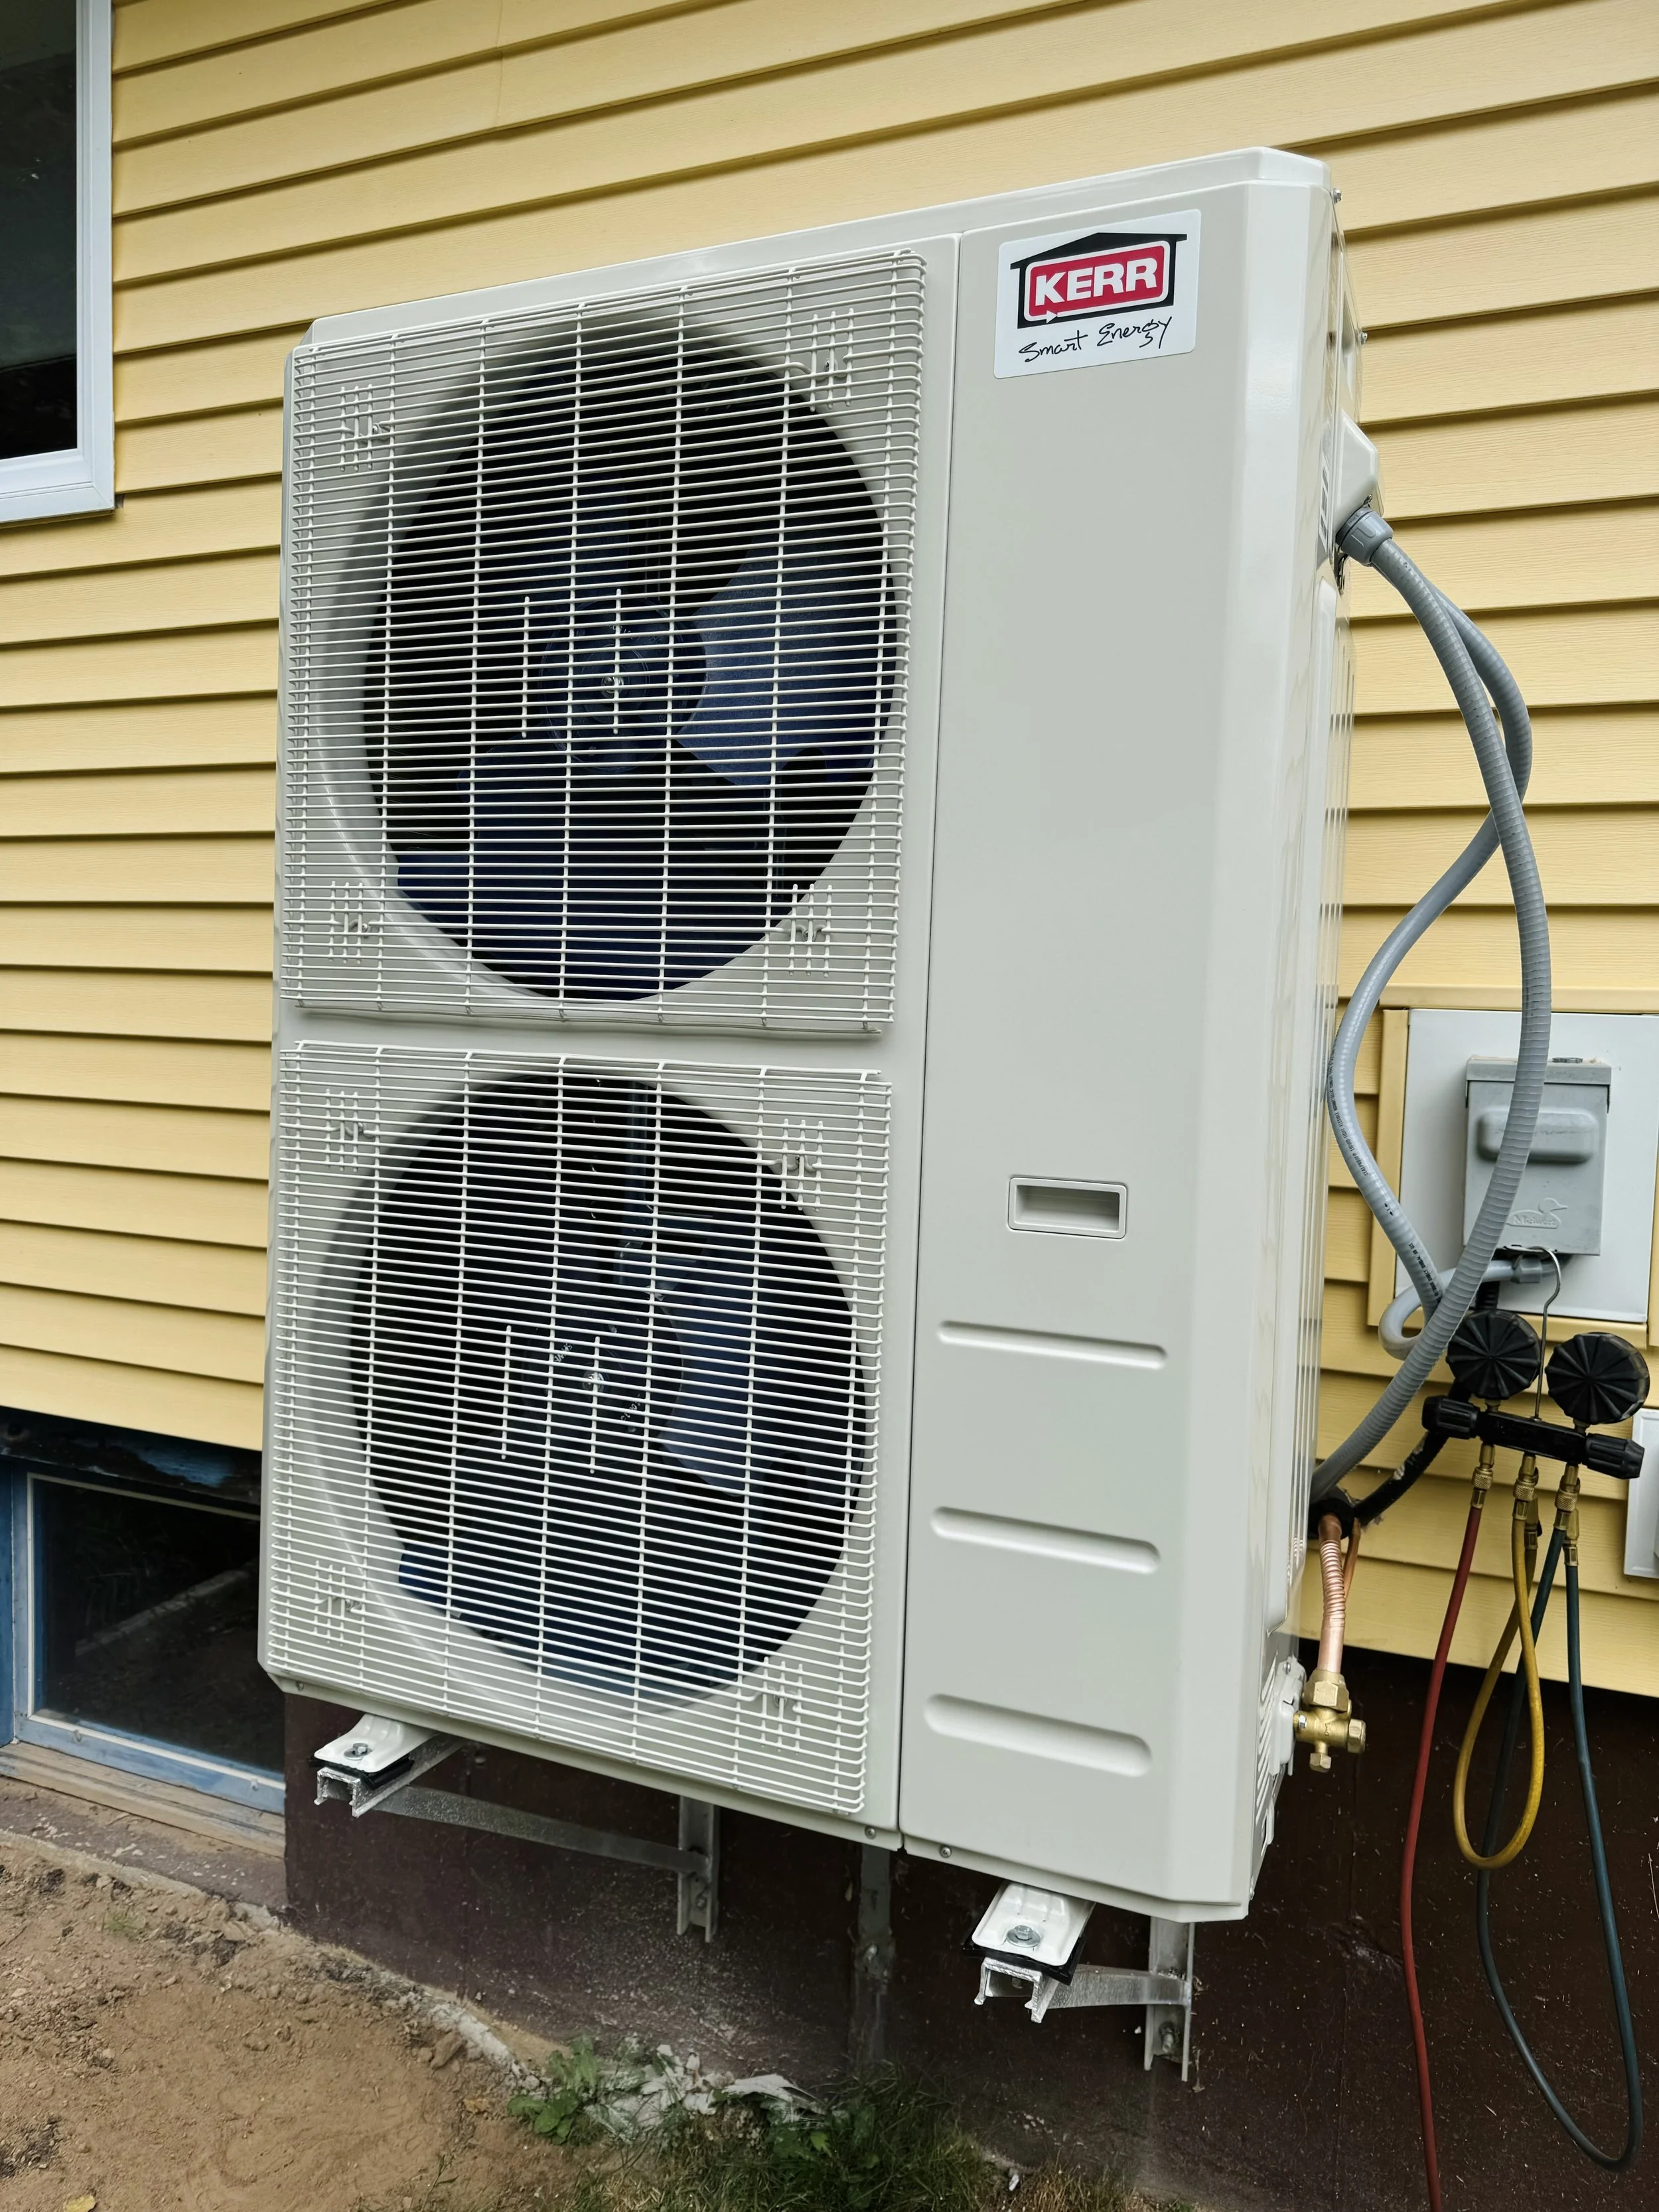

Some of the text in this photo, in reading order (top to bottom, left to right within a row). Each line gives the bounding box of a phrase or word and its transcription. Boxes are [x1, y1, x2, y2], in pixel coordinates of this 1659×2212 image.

[1035, 258, 1157, 307] KERR
[1018, 316, 1173, 363] Smart Energy
